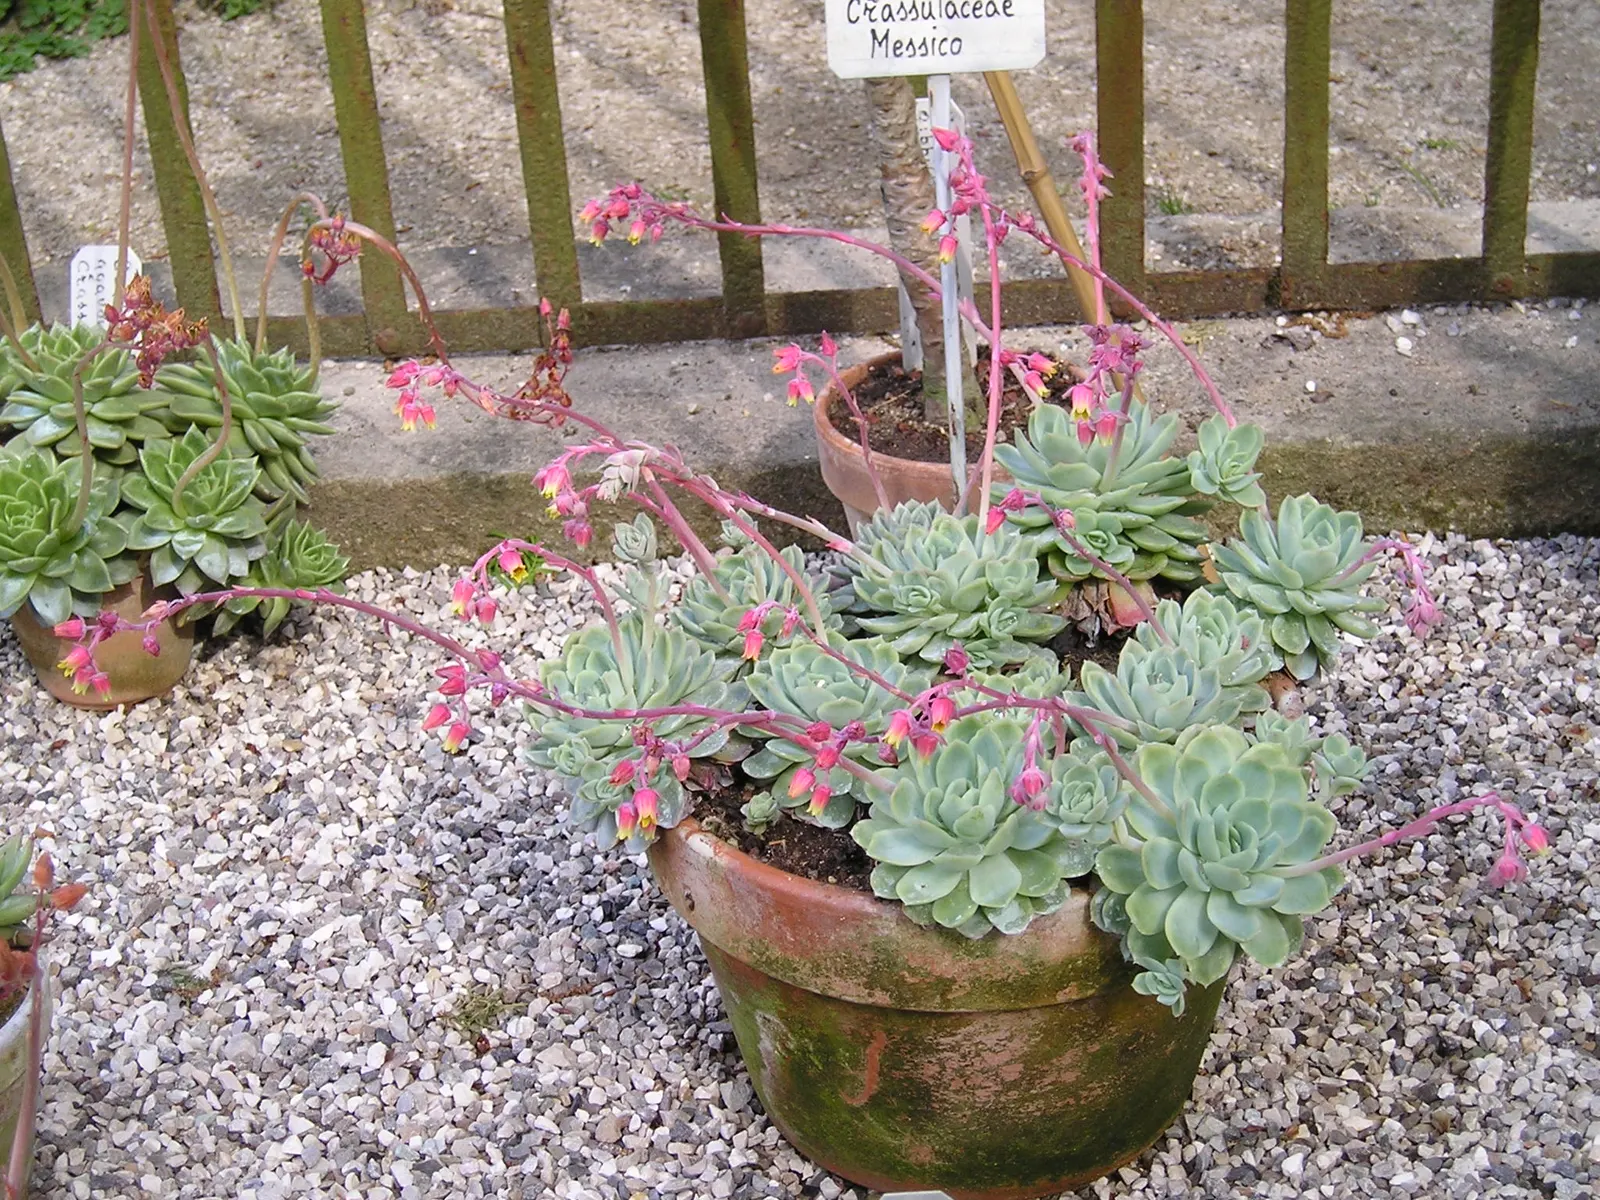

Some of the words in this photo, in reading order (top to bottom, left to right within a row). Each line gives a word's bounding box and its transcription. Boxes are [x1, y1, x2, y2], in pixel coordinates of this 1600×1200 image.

[847, 0, 1014, 24] Crassulaceae
[870, 26, 962, 59] Messico
[76, 260, 89, 320] Crass
